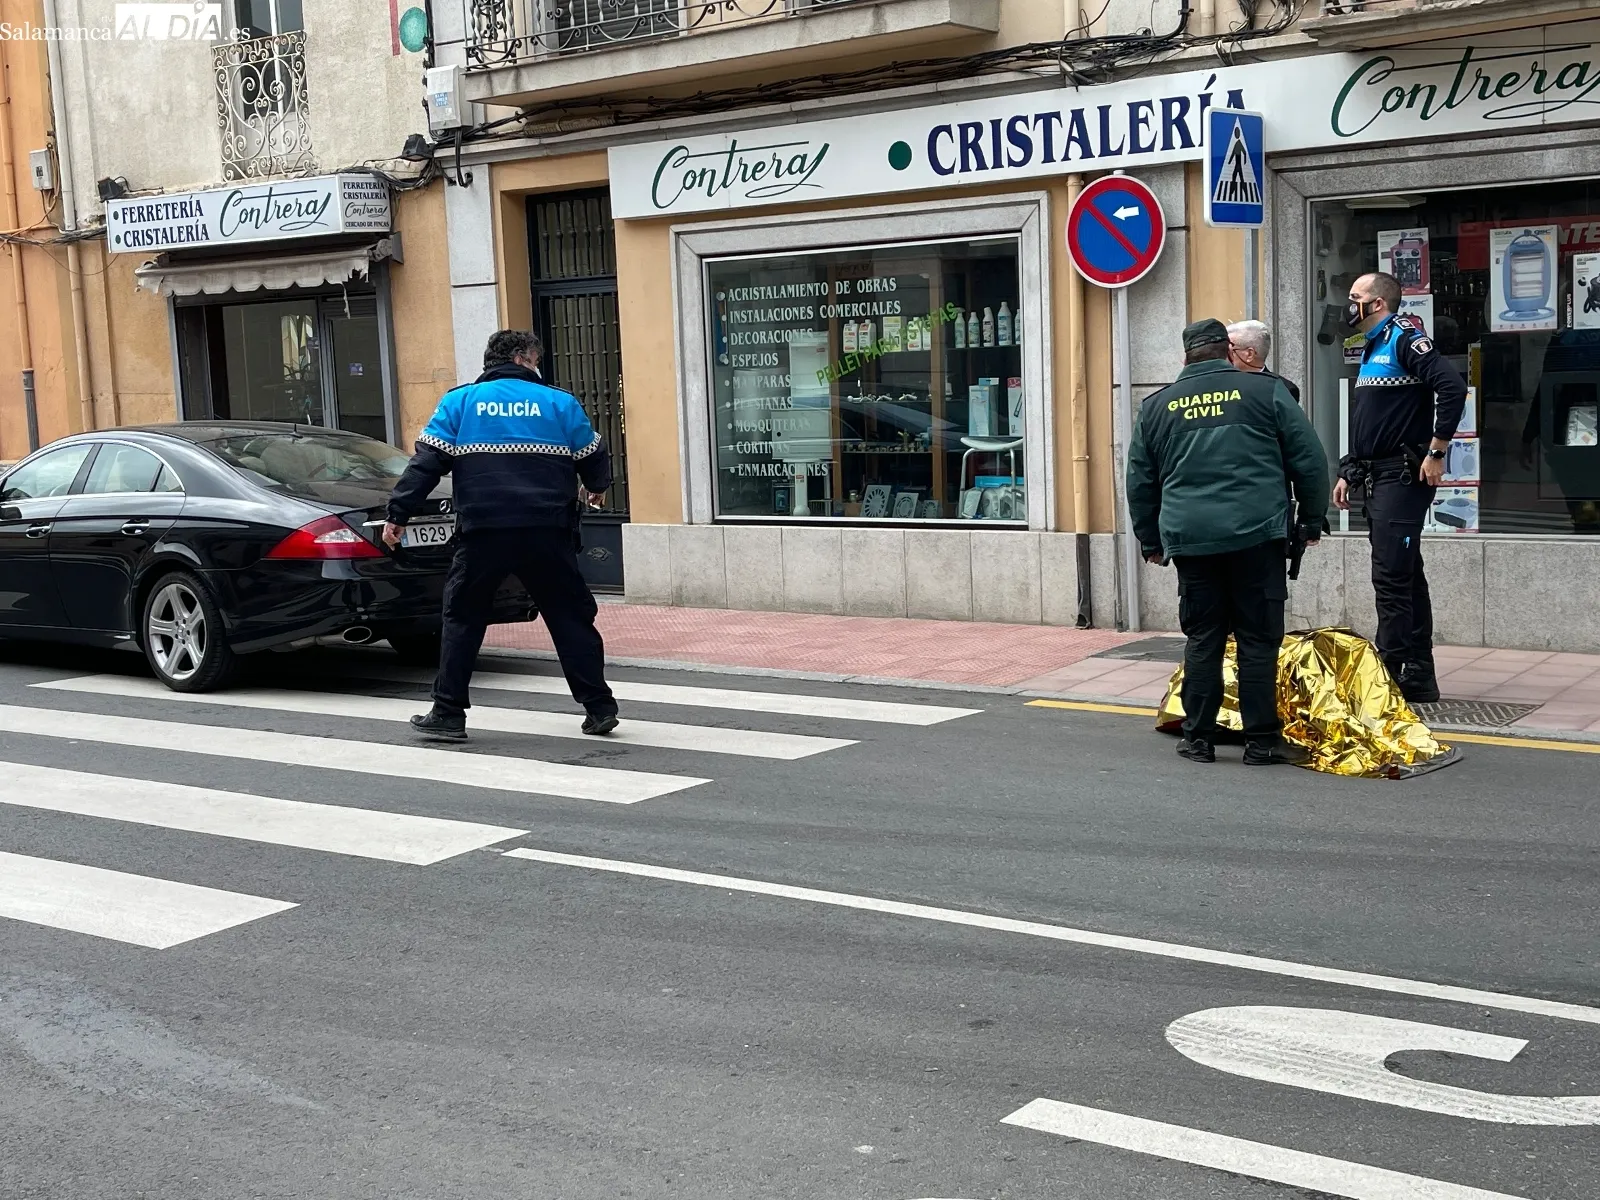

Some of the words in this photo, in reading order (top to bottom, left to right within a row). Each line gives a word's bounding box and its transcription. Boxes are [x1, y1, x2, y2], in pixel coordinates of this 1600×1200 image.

[343, 180, 385, 190] FERRETERÍA
[343, 190, 387, 200] CRISTALERÍA
[121, 195, 204, 224] FERRETERÍA
[123, 219, 210, 248] CRISTALERÍA
[728, 282, 829, 301] ACRISTALAMIENTO
[835, 280, 851, 295] DE
[856, 277, 897, 294] OBRAS
[730, 305, 814, 324] INSTALACIONES
[819, 300, 901, 319] COMERCIALES
[730, 328, 814, 346] DECORACIONES
[732, 353, 779, 368] ESPEJOS
[816, 351, 862, 387] PELLET
[477, 399, 541, 417] POLICÍA
[1167, 389, 1242, 412] GUARDIA
[1183, 404, 1224, 420] CIVIL
[735, 418, 811, 434] MOSQUITERAS
[736, 441, 790, 454] CORTINAS
[738, 462, 829, 477] ENMARCACNES
[412, 526, 447, 543] 1629
